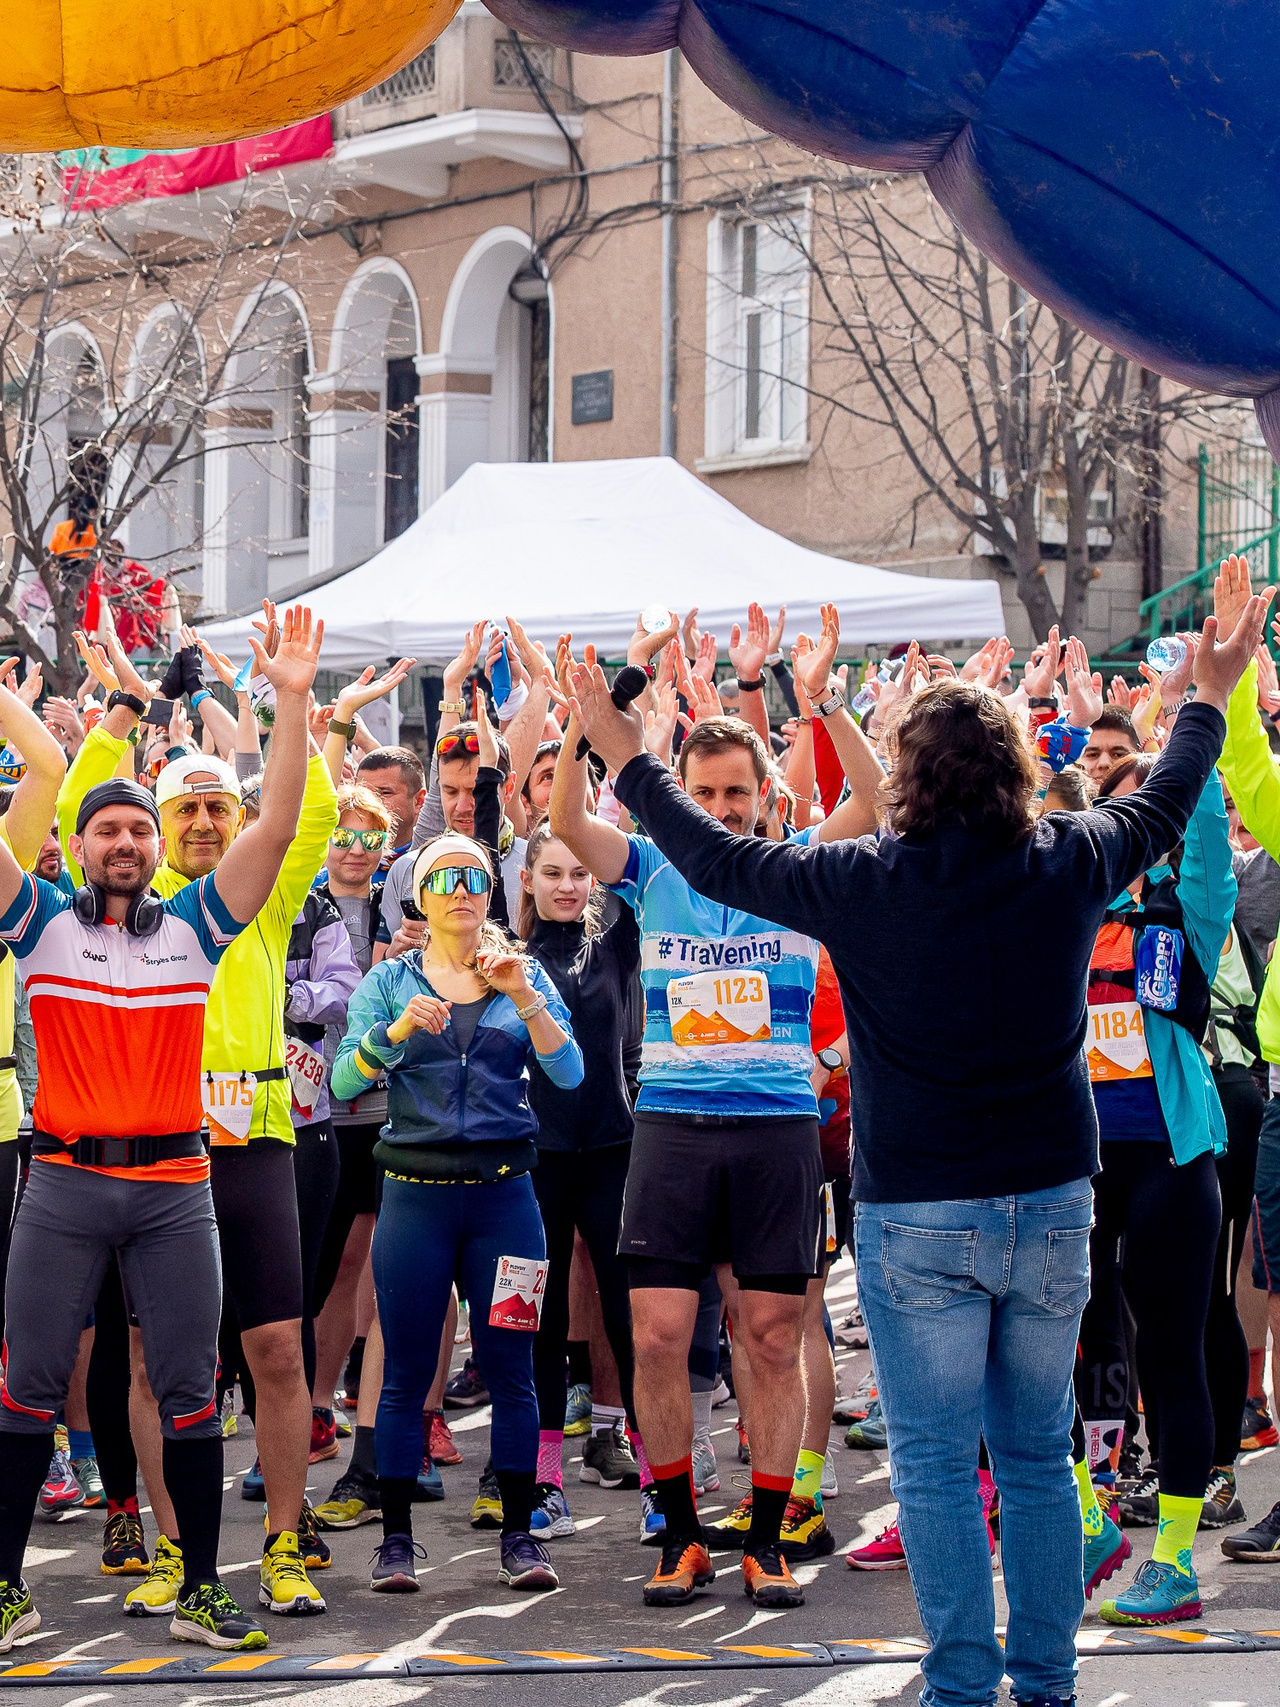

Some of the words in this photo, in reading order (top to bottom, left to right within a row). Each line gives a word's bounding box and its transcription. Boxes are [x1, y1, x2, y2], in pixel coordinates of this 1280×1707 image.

[671, 997, 682, 1005] 12K
[713, 976, 764, 1005] 1123
[1092, 1010, 1144, 1040] 1184
[285, 1043, 324, 1087] 2438
[207, 1080, 253, 1106] 1175
[499, 1278, 512, 1287] 22K
